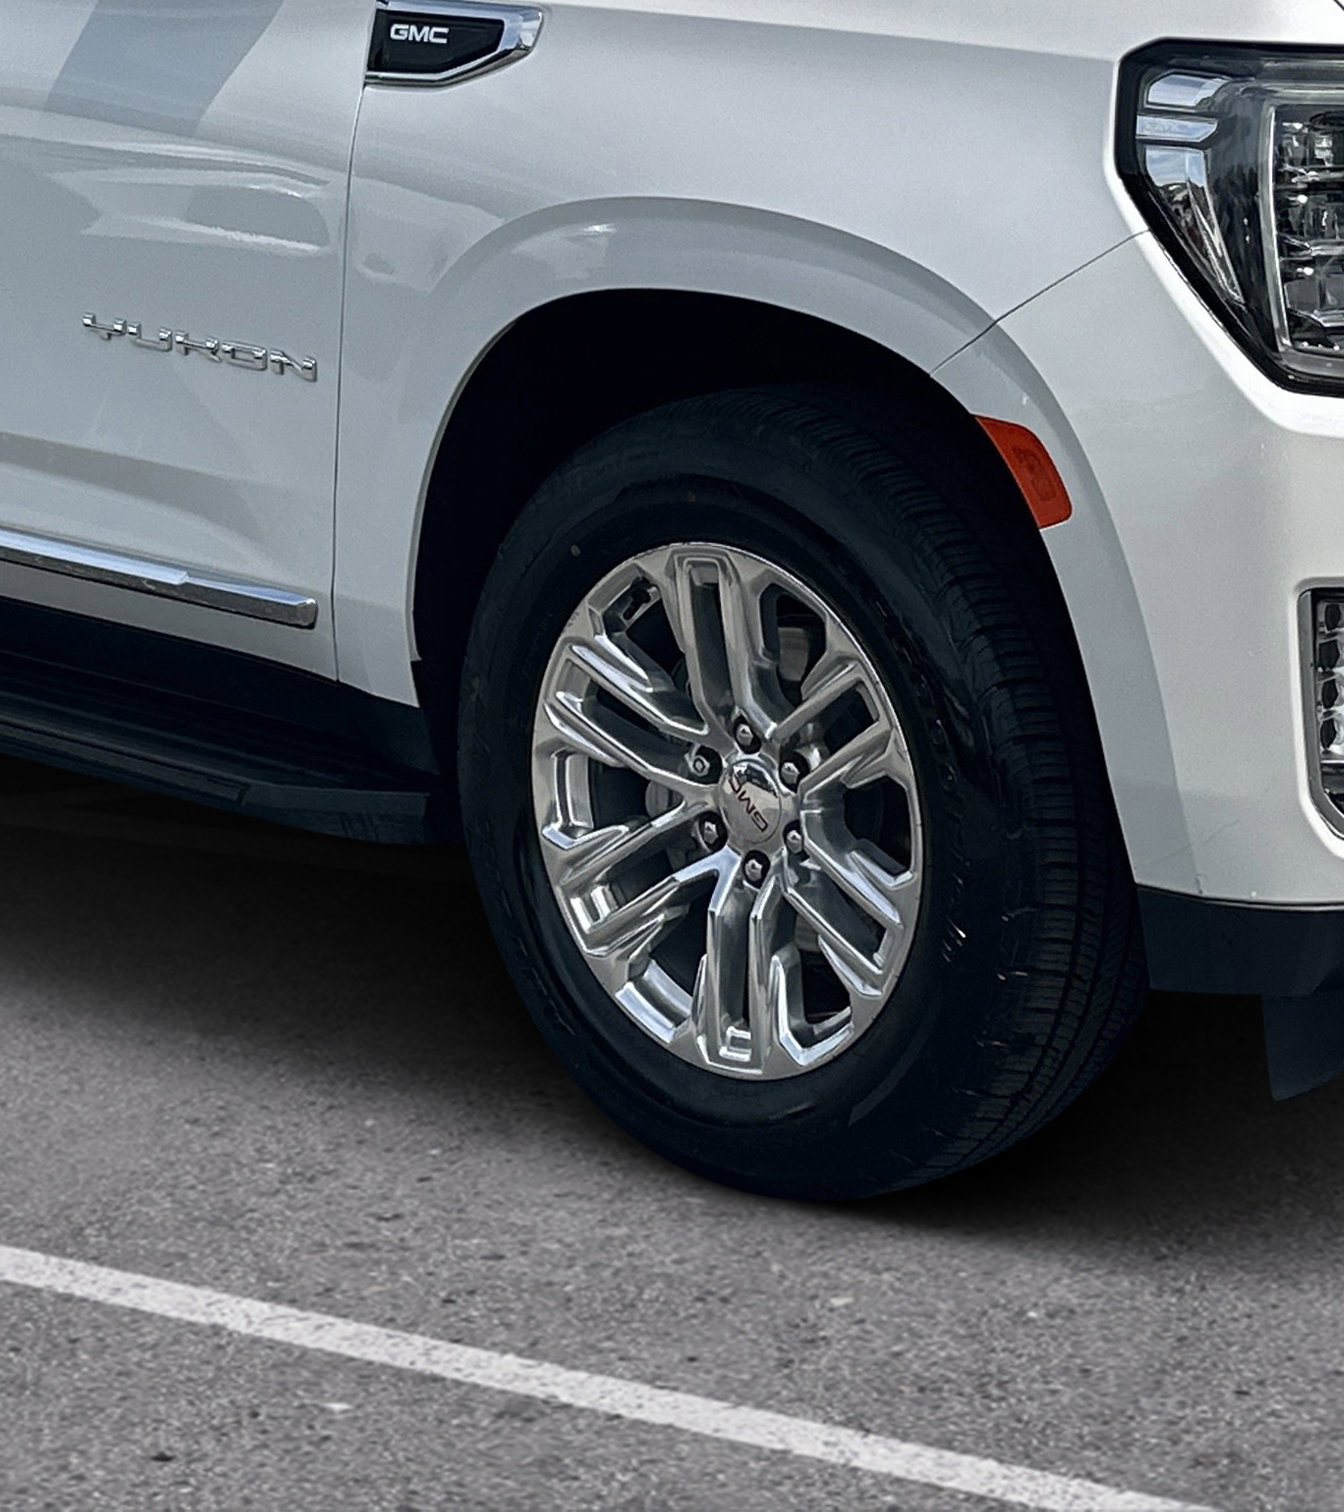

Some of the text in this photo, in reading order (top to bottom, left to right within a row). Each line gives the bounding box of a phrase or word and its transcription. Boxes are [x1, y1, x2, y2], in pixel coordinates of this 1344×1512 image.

[390, 23, 449, 44] GMC
[82, 313, 317, 382] YUKON
[729, 772, 768, 832] GMC
